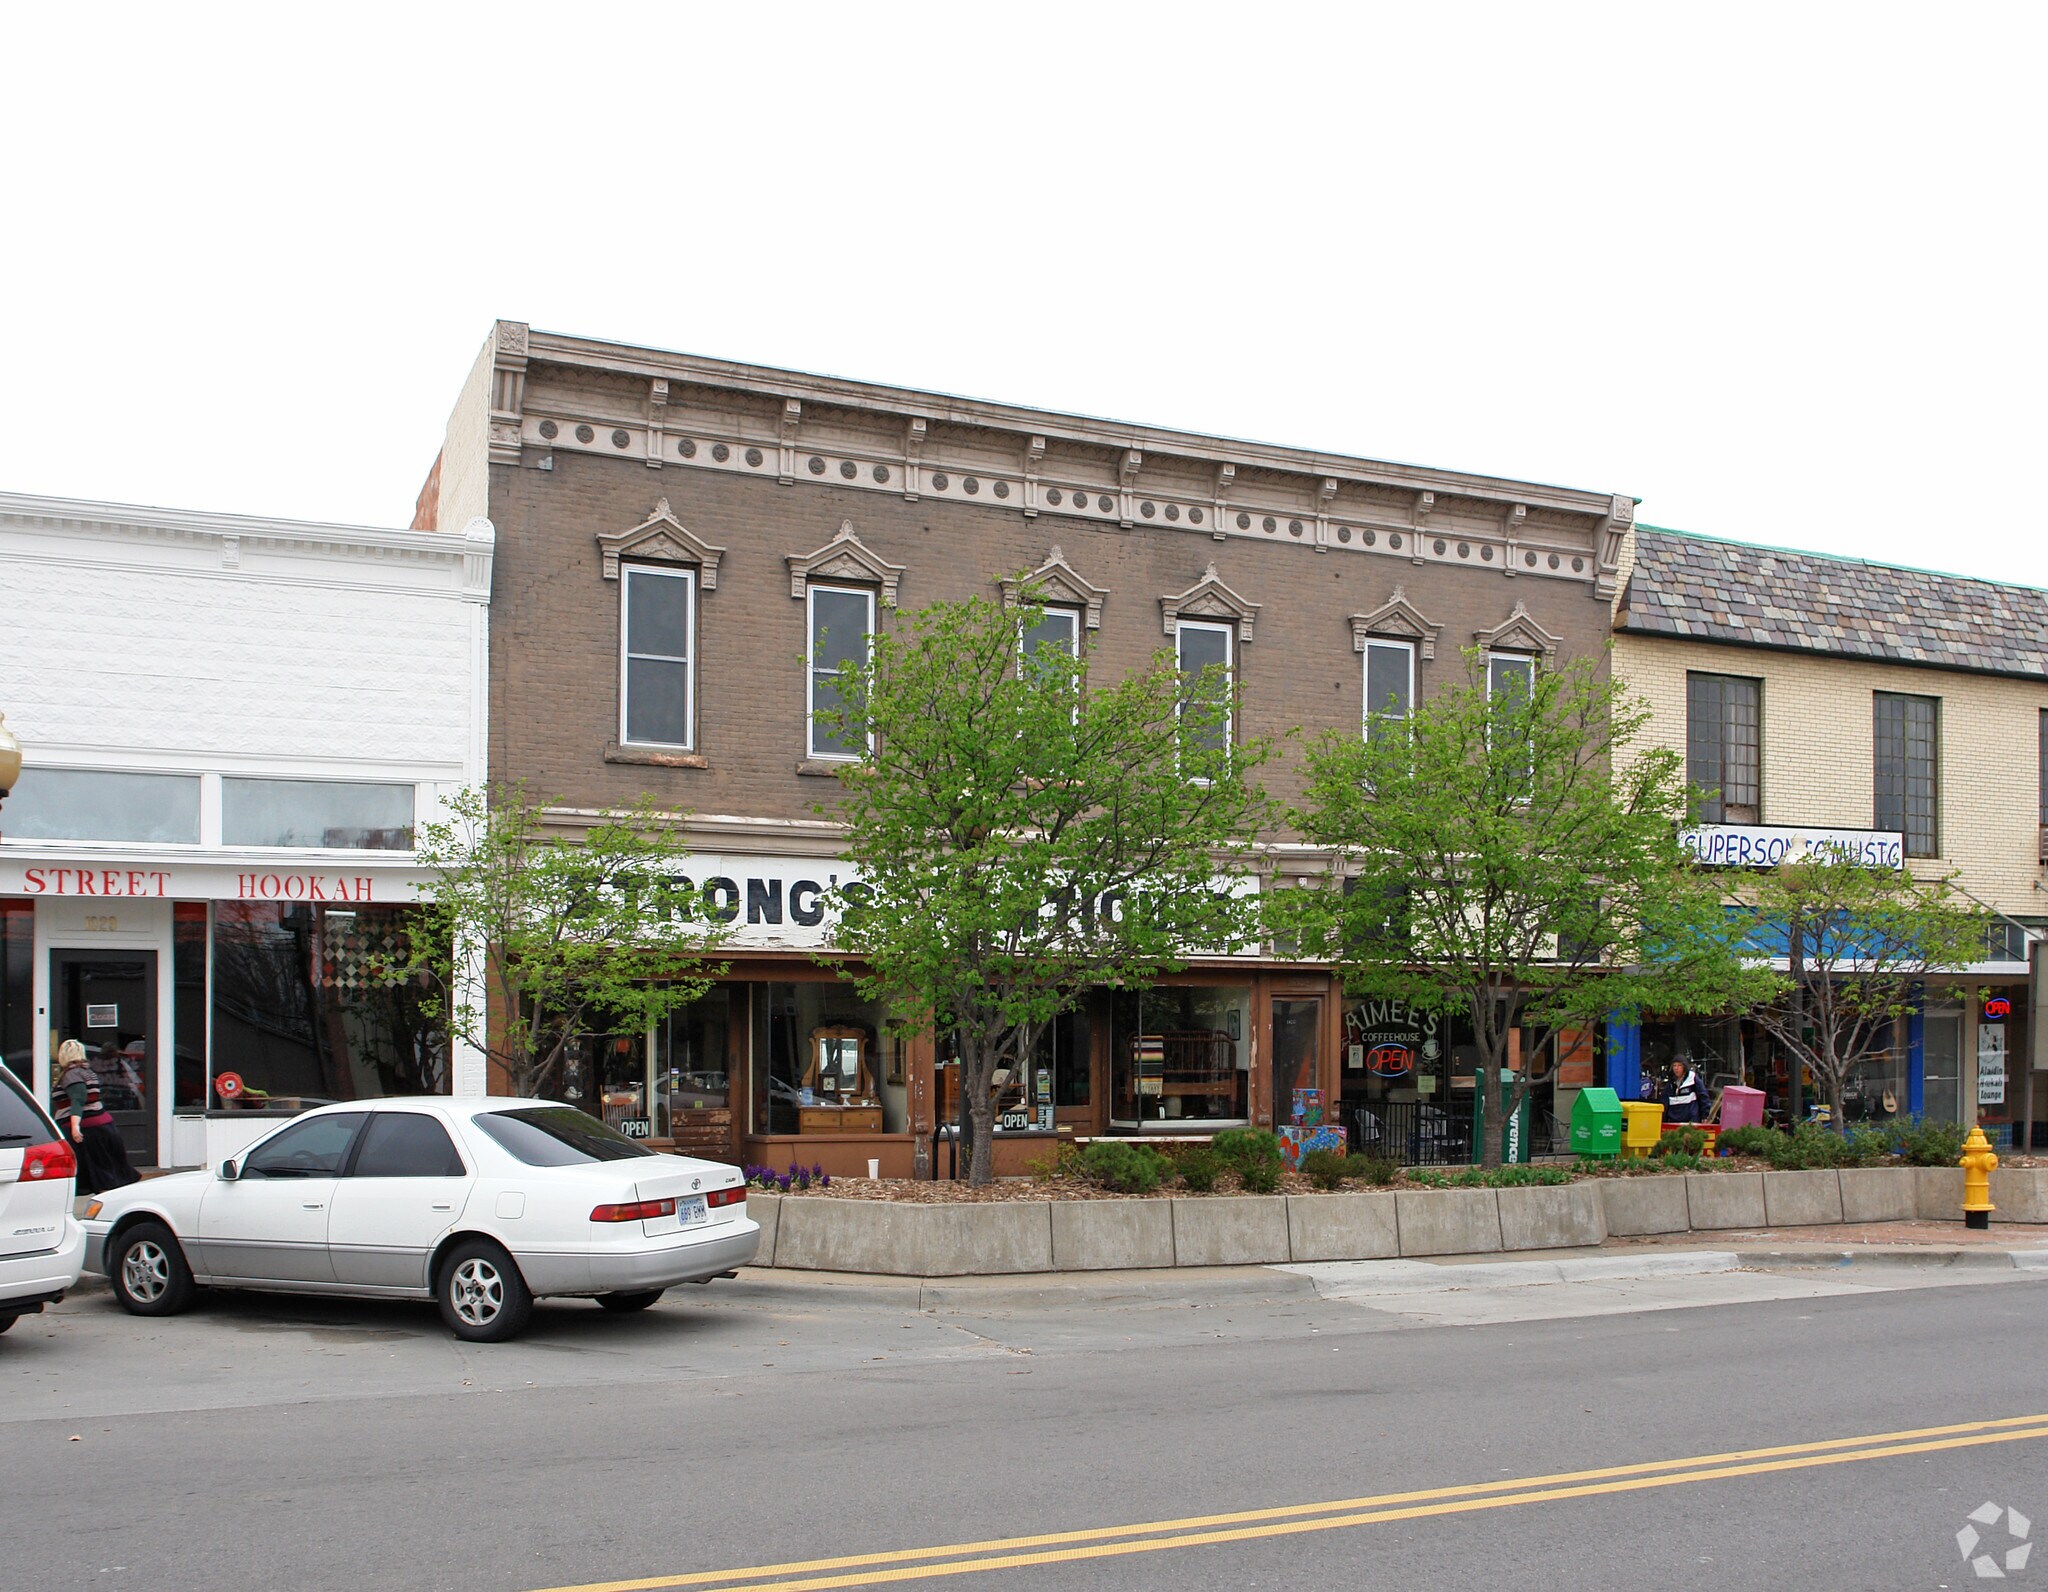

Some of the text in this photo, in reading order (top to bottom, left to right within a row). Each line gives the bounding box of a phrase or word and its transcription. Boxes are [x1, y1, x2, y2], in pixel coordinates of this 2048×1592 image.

[23, 868, 374, 900] STREET HOOKAH
[1985, 1001, 2011, 1014] OPEN
[1361, 1032, 1421, 1042] COFFEEHOUSE
[1366, 1049, 1415, 1071] OPEN
[1004, 1114, 1028, 1128] OPEN
[621, 1121, 649, 1136] OPEN
